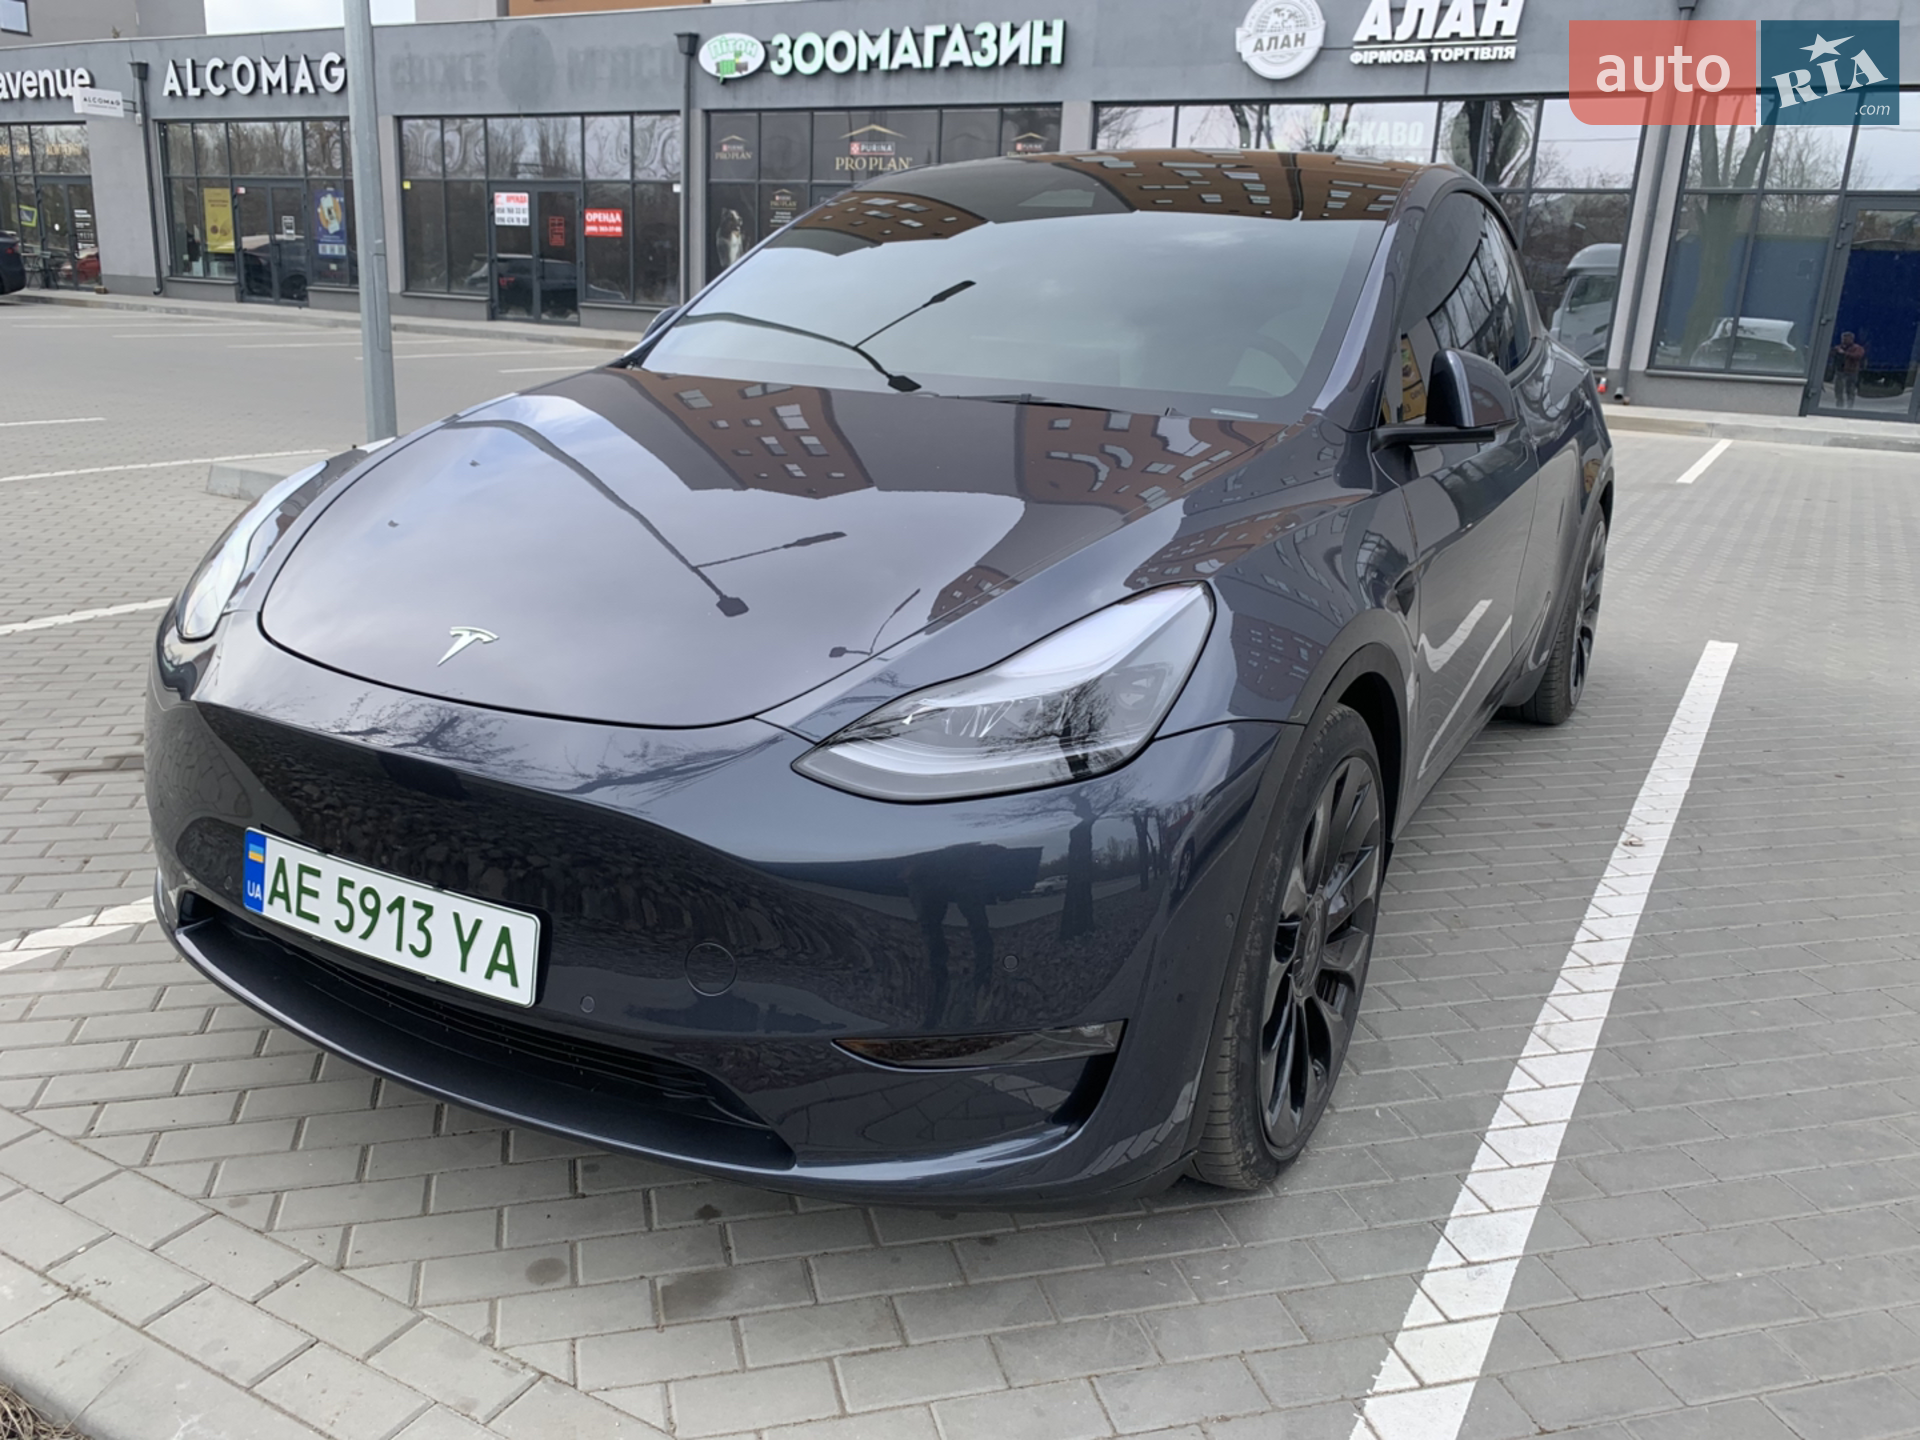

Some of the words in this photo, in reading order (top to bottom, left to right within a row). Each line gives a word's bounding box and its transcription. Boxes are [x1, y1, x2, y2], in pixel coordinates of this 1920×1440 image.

[1352, 0, 1525, 42] АЛАН
[770, 19, 1064, 76] ЗООМАГАЗИН
[1253, 32, 1306, 53] АЛАН
[1350, 50, 1426, 64] ФІРМОВА
[1431, 46, 1516, 62] ТОРГІВЛЯ
[0, 68, 91, 98] avenue
[163, 52, 346, 97] ALCOMAG
[83, 97, 121, 106] ALCOMAG
[861, 143, 893, 152] PURINA
[835, 156, 868, 171] PRO
[869, 156, 911, 171] PLAN
[585, 212, 622, 223] ОРЕНДА
[247, 880, 263, 900] UA
[267, 856, 322, 924] AE
[333, 876, 434, 958] 5913
[453, 911, 519, 988] YA
